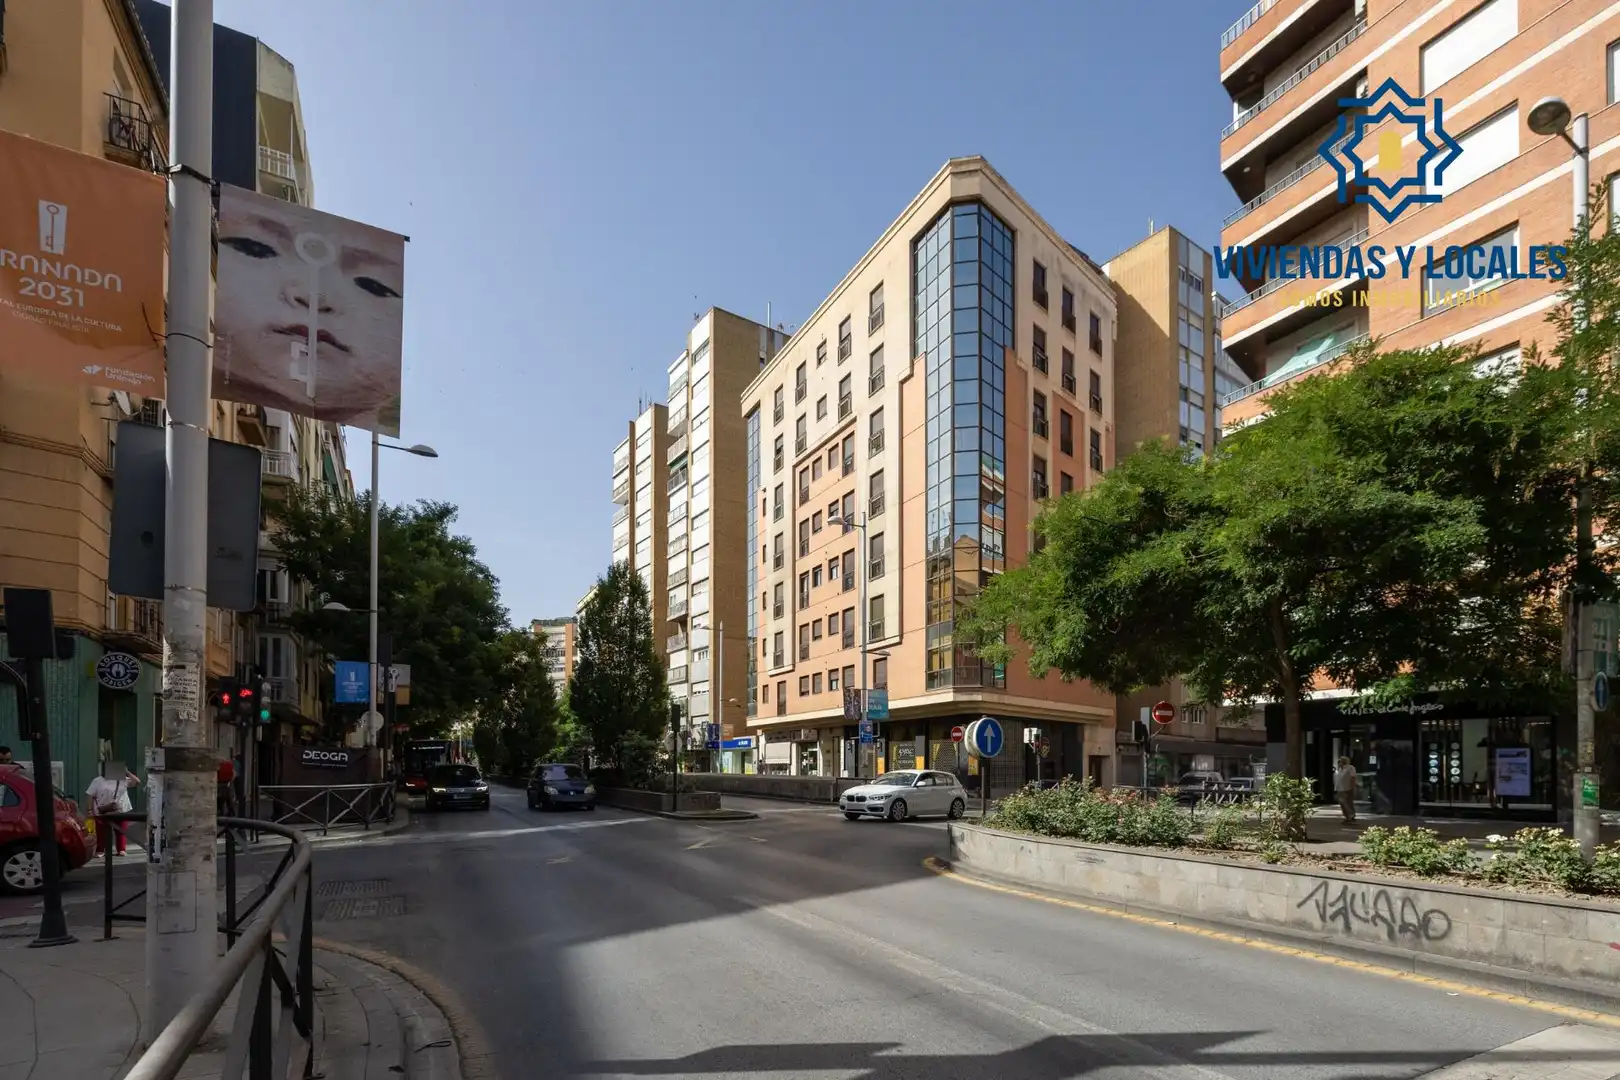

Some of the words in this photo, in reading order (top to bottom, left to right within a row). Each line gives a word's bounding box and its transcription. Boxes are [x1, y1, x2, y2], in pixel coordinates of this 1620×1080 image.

[0, 249, 122, 292] RANADA
[18, 277, 84, 307] 2031
[84, 317, 122, 332] CULTURA
